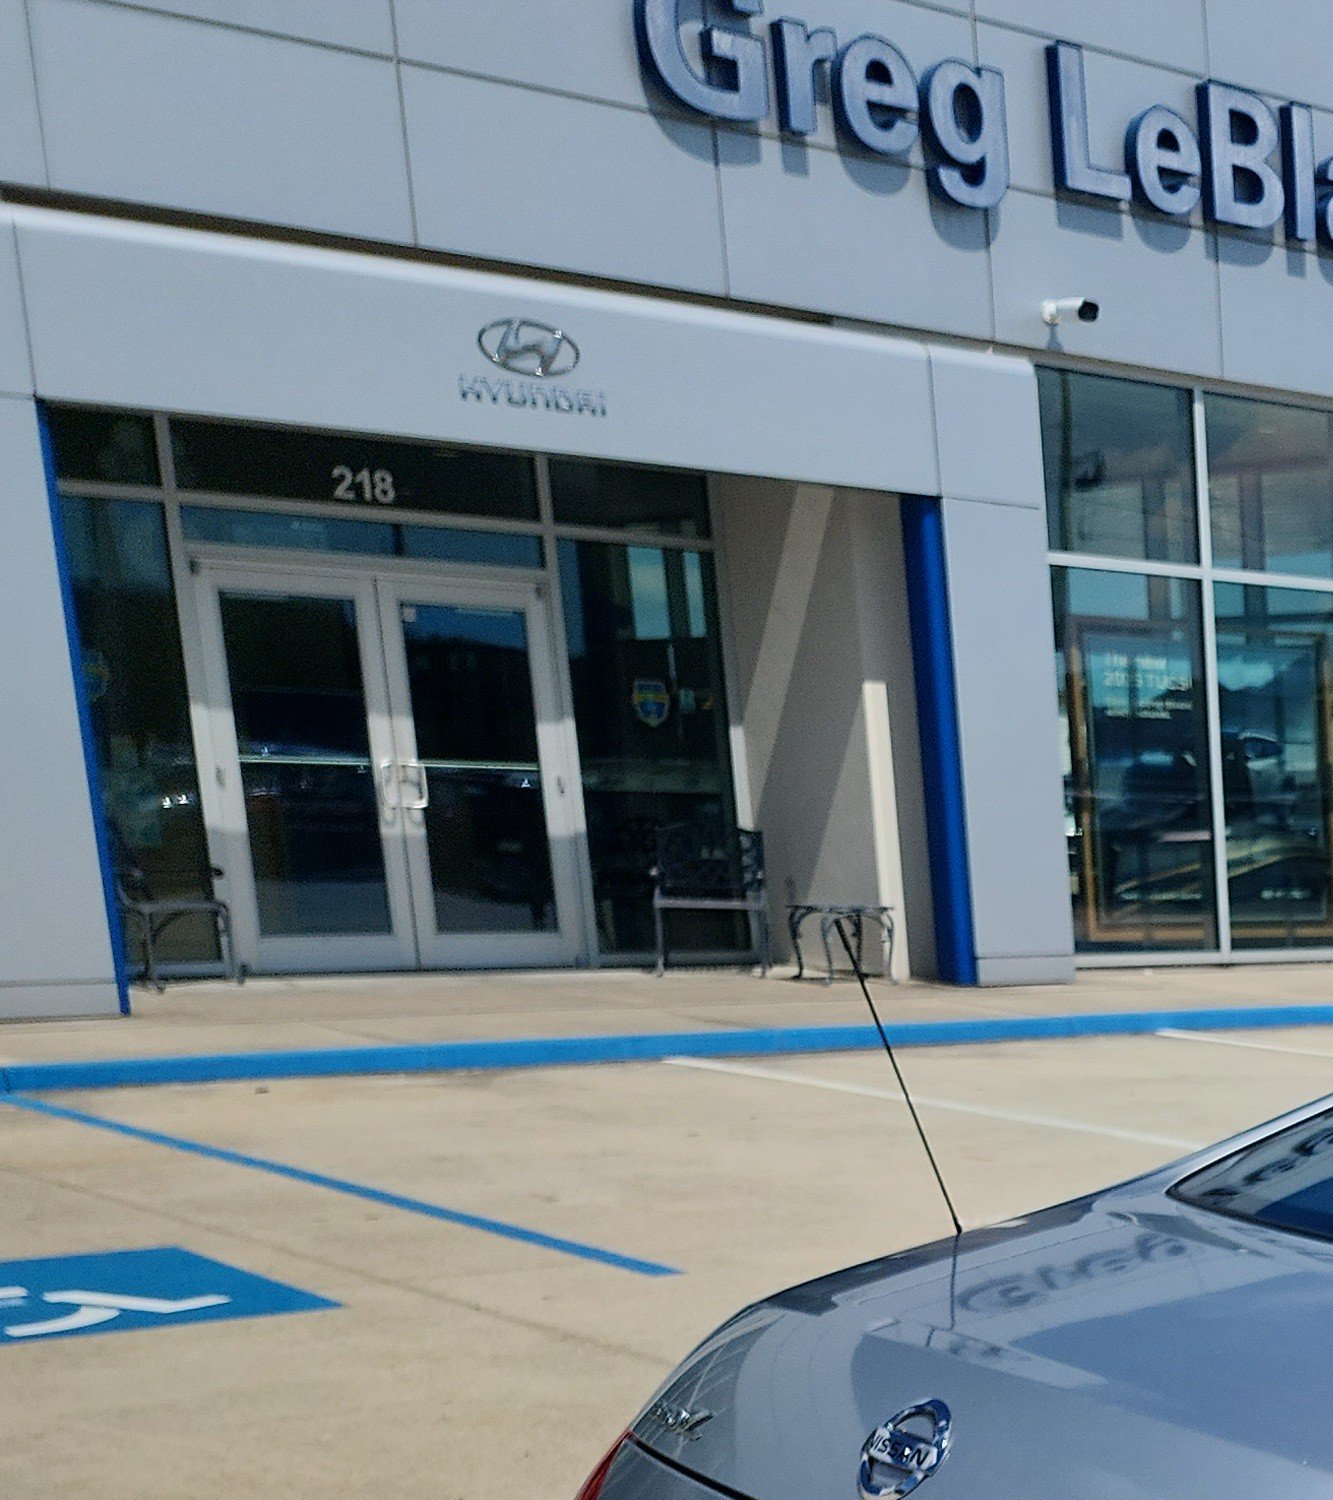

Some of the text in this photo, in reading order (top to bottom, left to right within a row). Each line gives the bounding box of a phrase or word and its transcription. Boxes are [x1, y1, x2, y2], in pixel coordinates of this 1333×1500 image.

[633, 0, 1010, 209] Greg
[457, 374, 608, 418] HYUNDAI
[331, 464, 396, 503] 218
[868, 1432, 930, 1468] NISSAN
